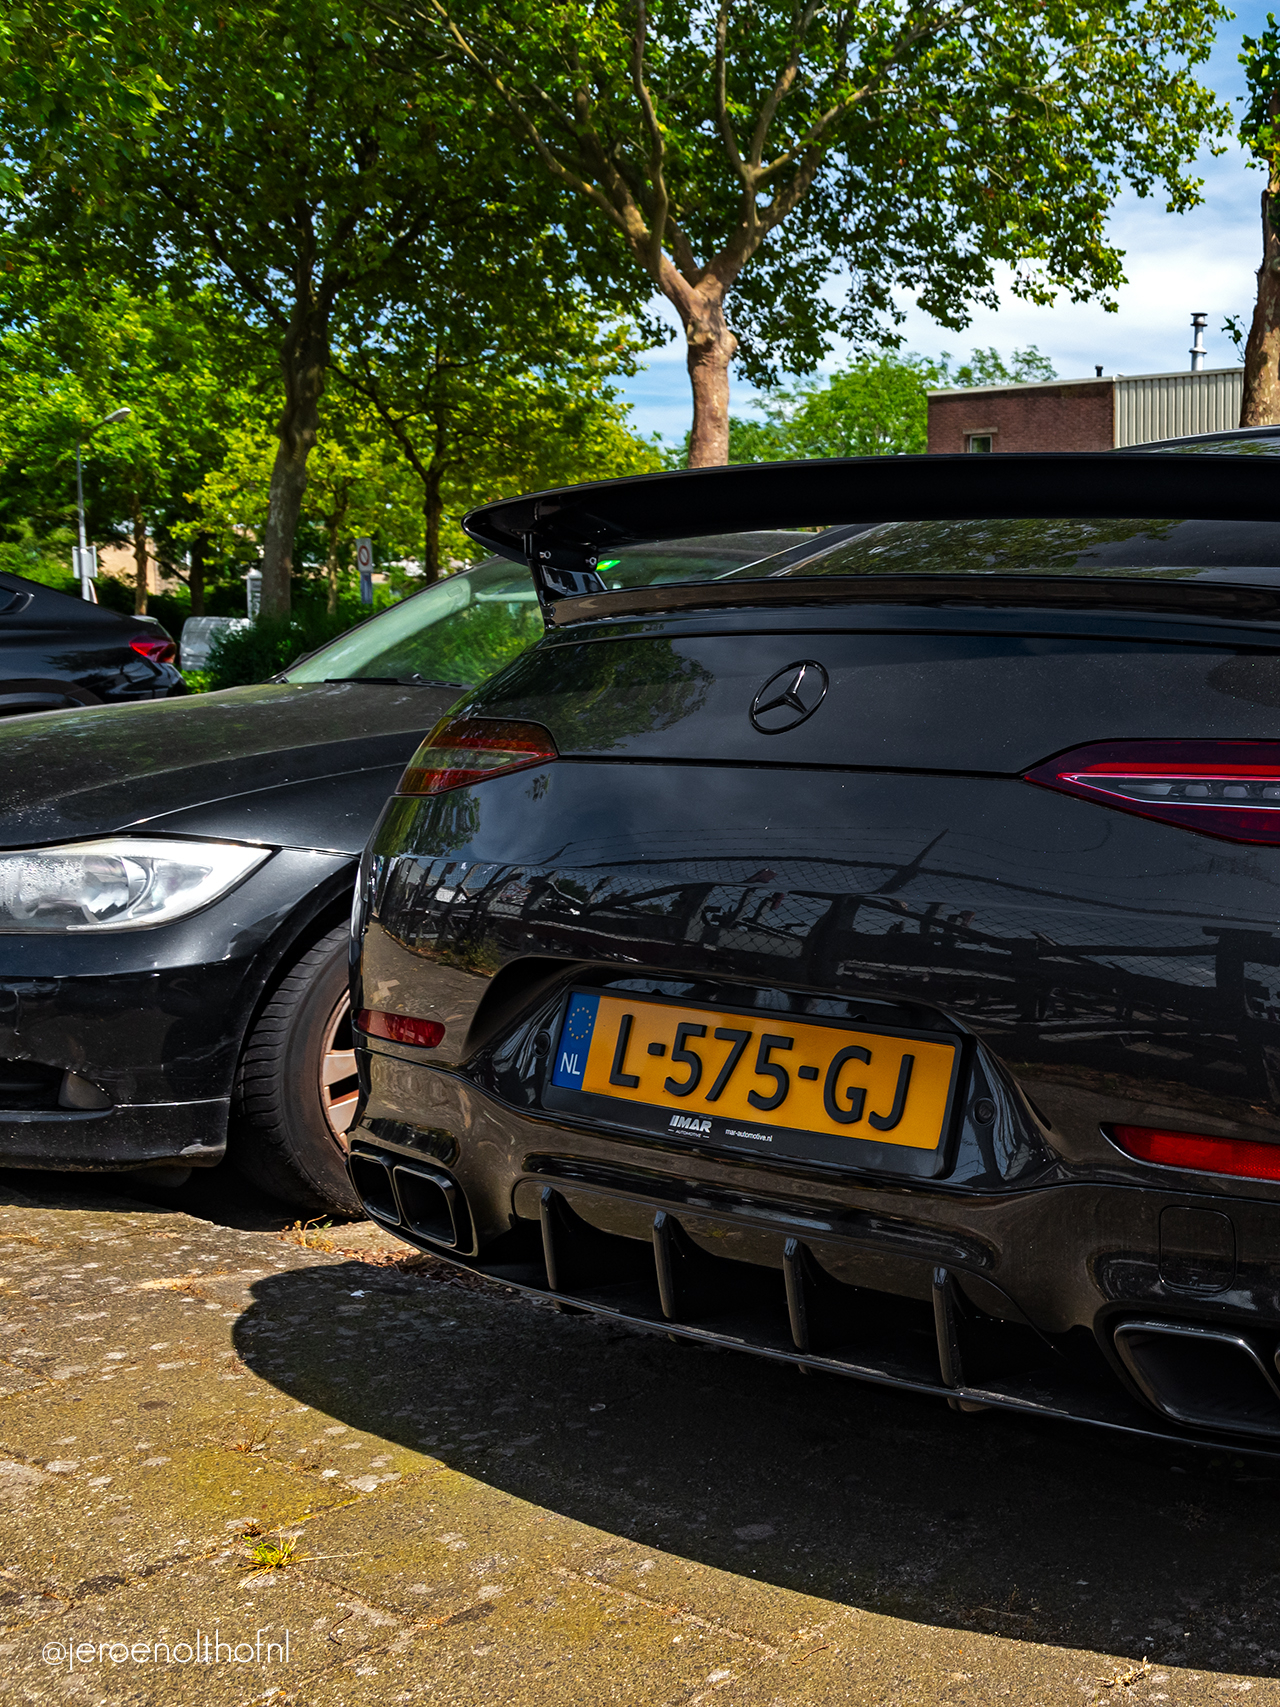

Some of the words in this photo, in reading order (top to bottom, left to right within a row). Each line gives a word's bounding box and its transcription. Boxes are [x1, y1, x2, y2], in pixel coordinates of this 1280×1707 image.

[560, 1052, 581, 1076] NL
[608, 1014, 915, 1132] L-575-GJ
[675, 1130, 702, 1138] AUTOMOTIVE
[725, 1129, 773, 1142] mar-automotive.nl
